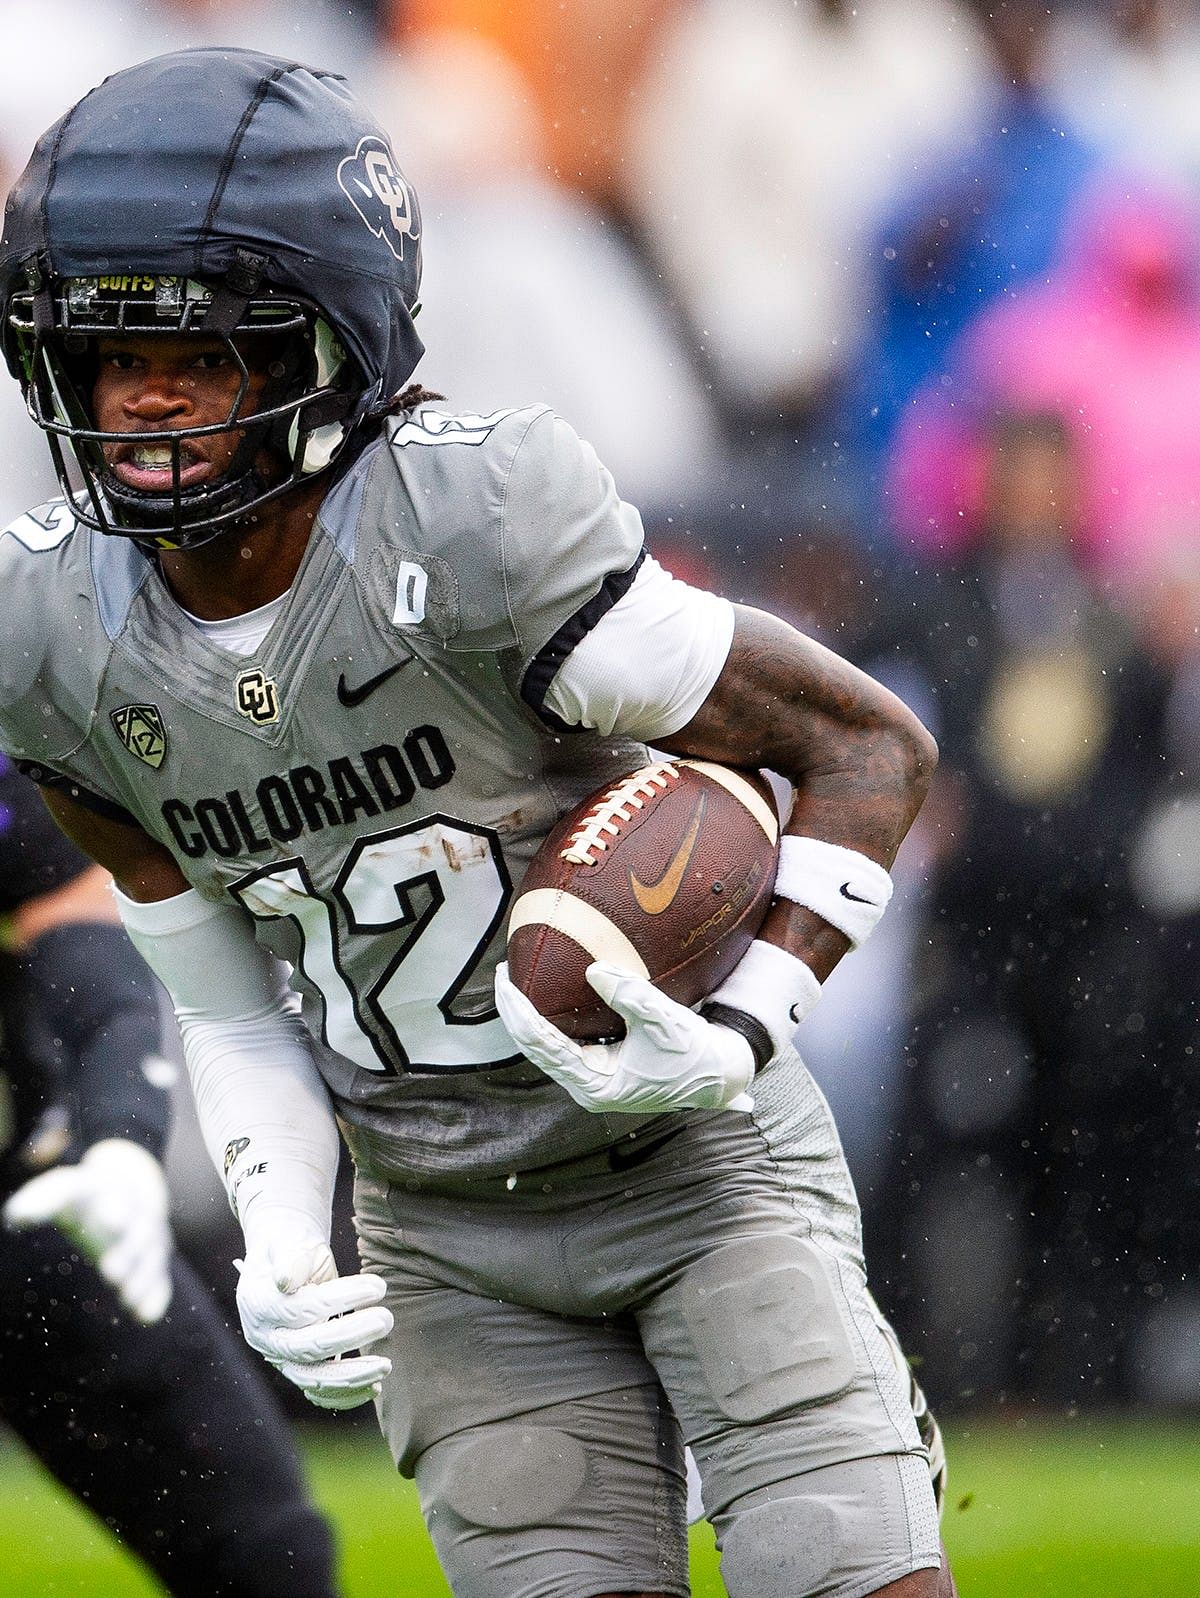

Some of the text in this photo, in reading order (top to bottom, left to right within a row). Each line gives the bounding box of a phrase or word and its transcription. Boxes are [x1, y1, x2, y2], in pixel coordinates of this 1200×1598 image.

[234, 667, 281, 727] CU
[113, 705, 164, 748] PAC
[131, 732, 162, 757] 12
[160, 724, 456, 858] COLORADO
[225, 811, 527, 1077] 12
[681, 902, 732, 950] VAPOR
